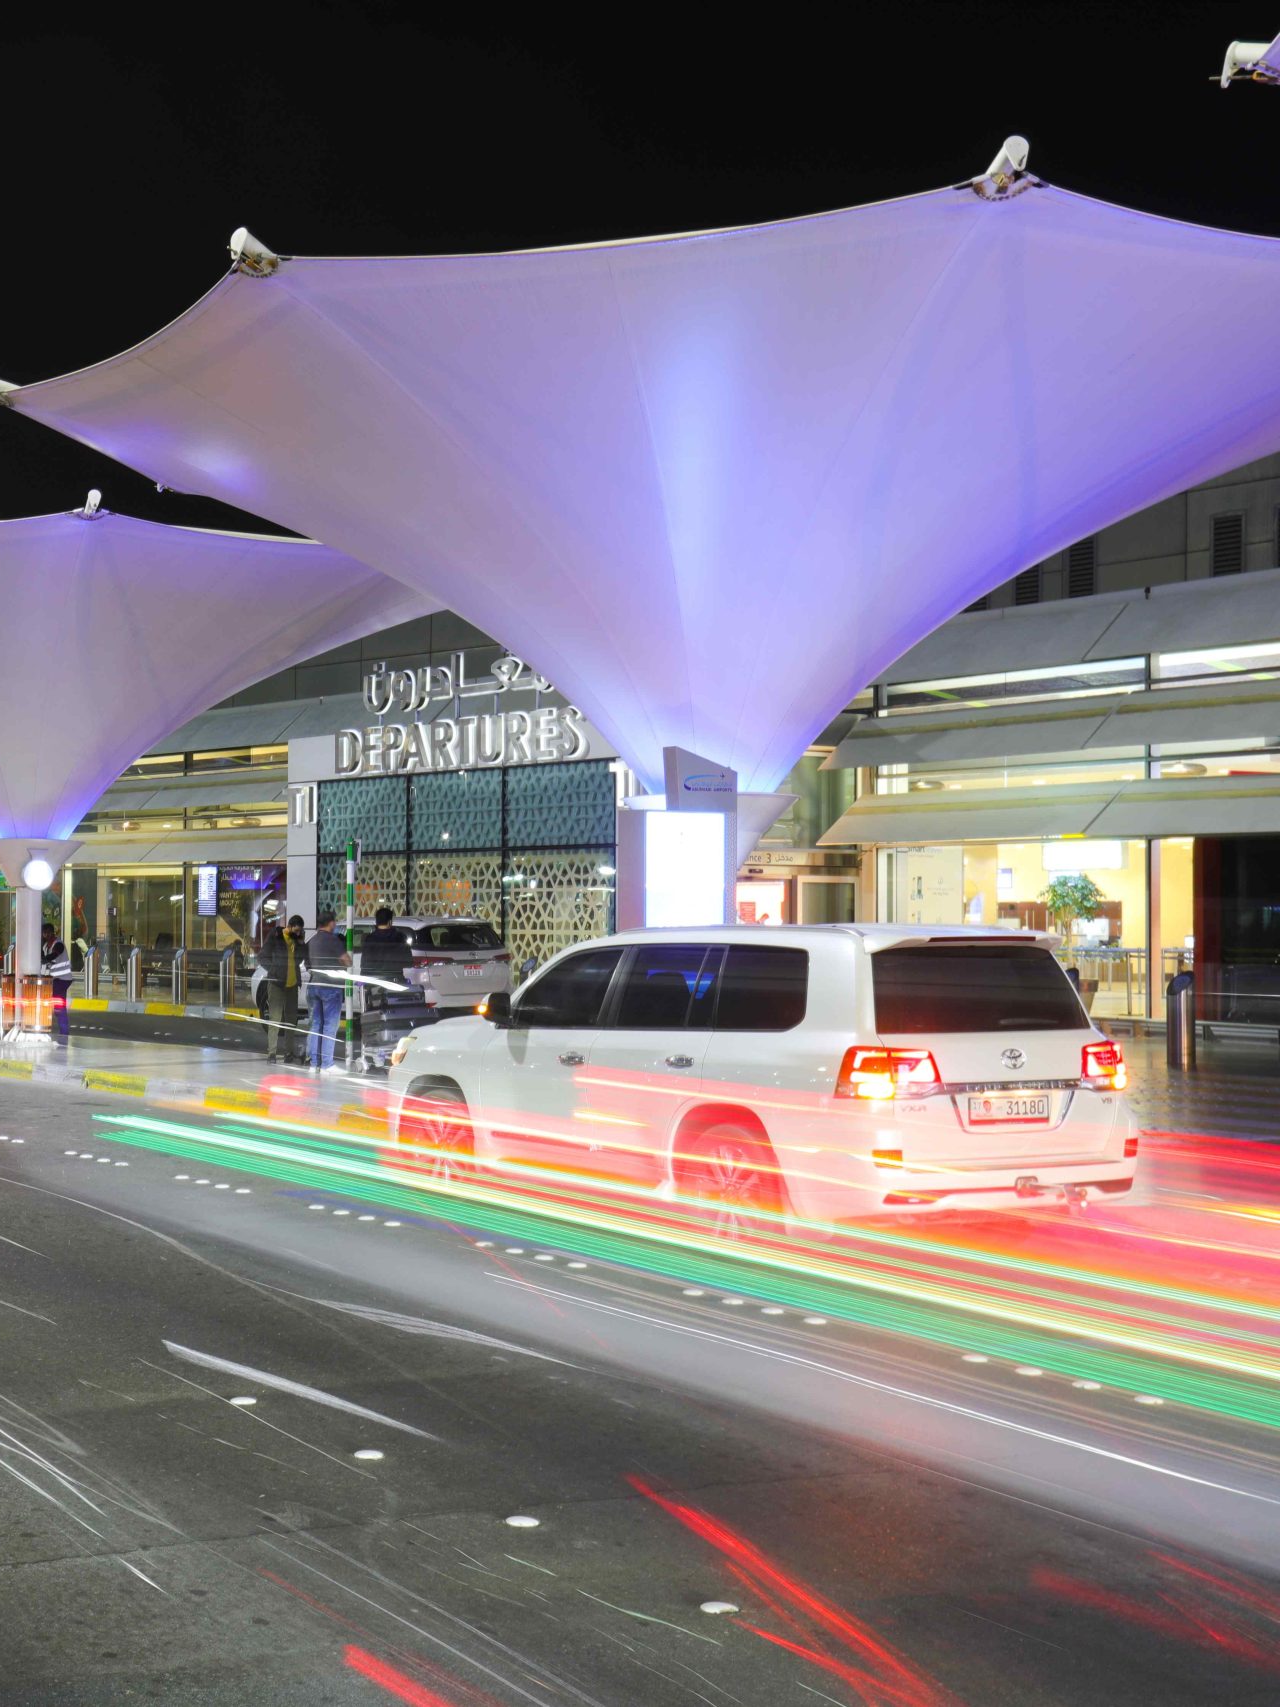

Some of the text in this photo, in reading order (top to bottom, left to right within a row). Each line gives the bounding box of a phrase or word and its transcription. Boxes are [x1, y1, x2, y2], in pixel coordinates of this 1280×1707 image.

[334, 706, 590, 776] DEPARTURES
[766, 853, 772, 863] 3
[774, 853, 793, 862] مدخل
[1006, 1099, 1045, 1116] 31180
